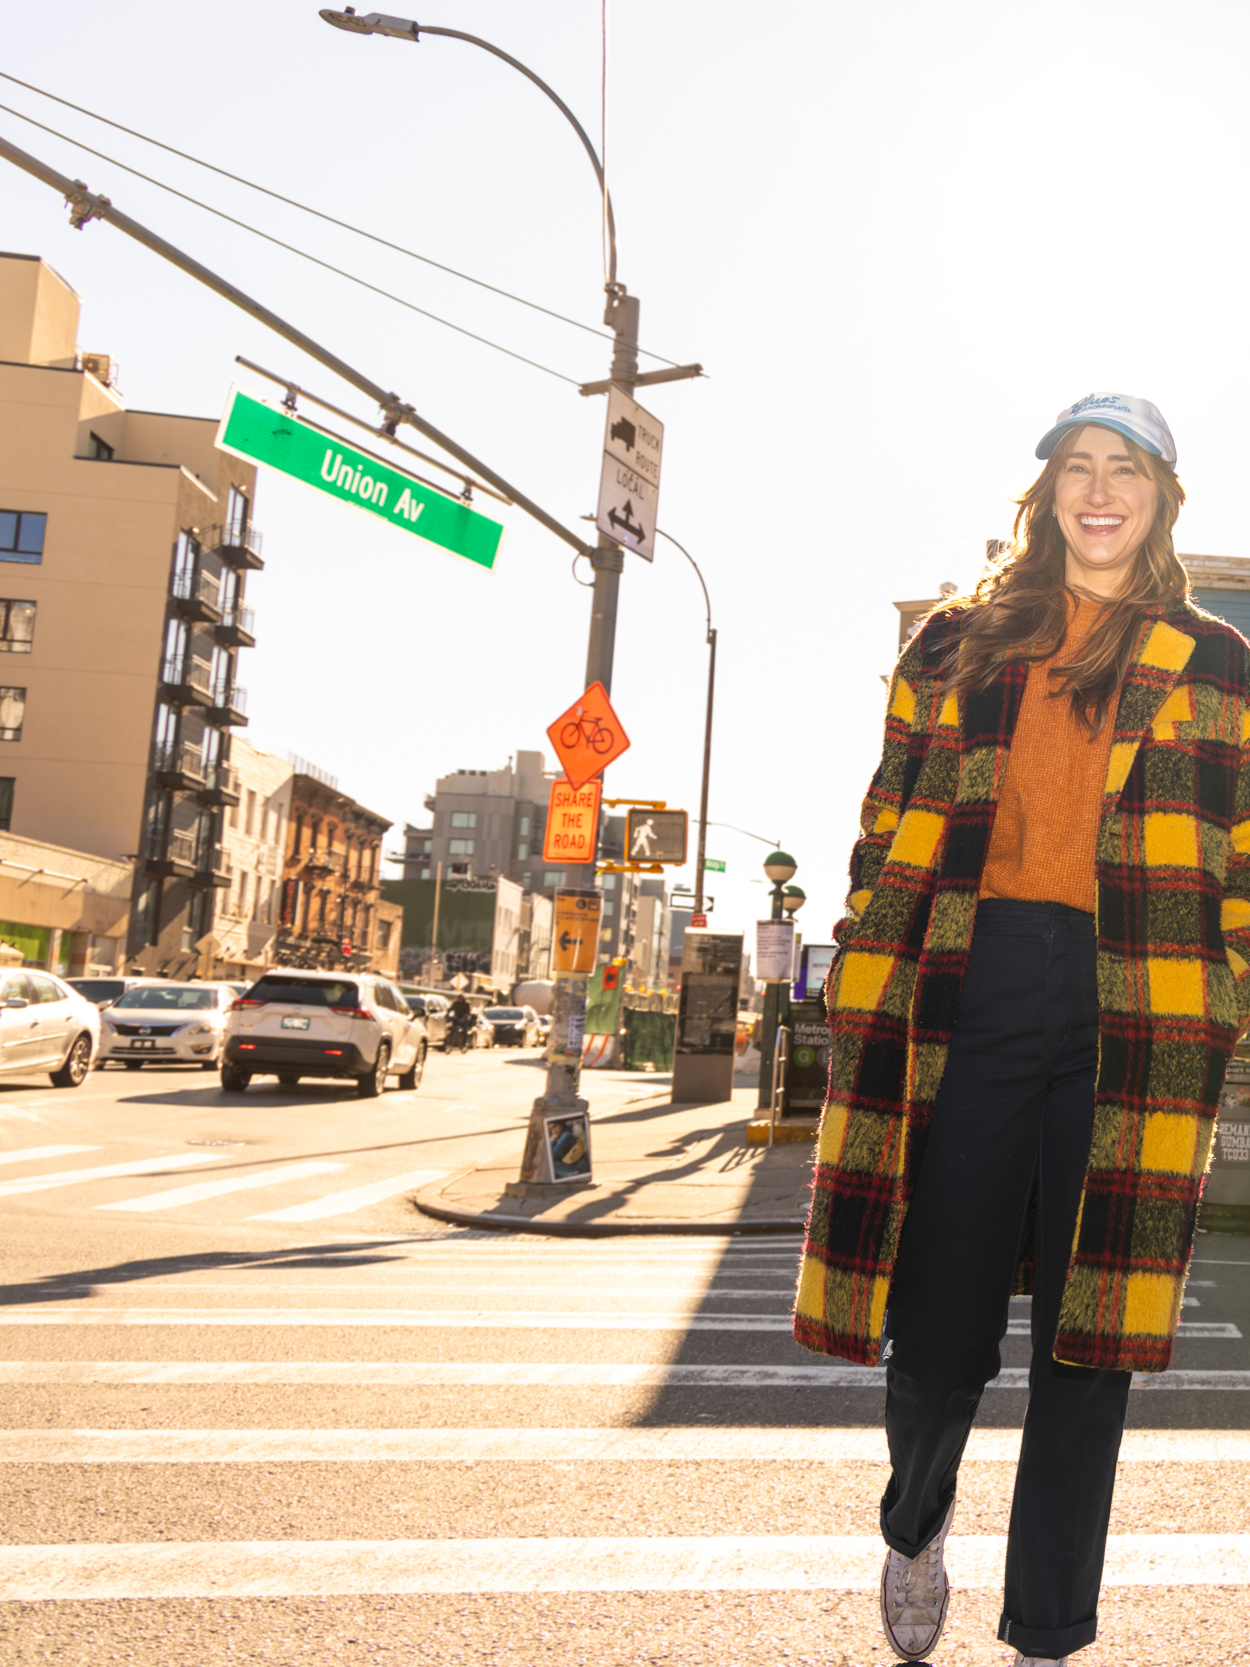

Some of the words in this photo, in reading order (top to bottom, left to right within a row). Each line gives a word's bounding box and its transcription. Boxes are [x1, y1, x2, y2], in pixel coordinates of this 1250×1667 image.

[638, 424, 660, 449] TRUCK
[635, 453, 658, 479] ROUTE
[321, 449, 389, 507] Union
[393, 488, 424, 522] Av
[616, 468, 644, 500] LOCAL
[555, 792, 594, 807] SHARE
[561, 813, 583, 828] THE
[553, 834, 587, 849] ROAD
[793, 1034, 829, 1046] Statio
[798, 1050, 810, 1063] G
[1223, 1148, 1250, 1161] TCU33
